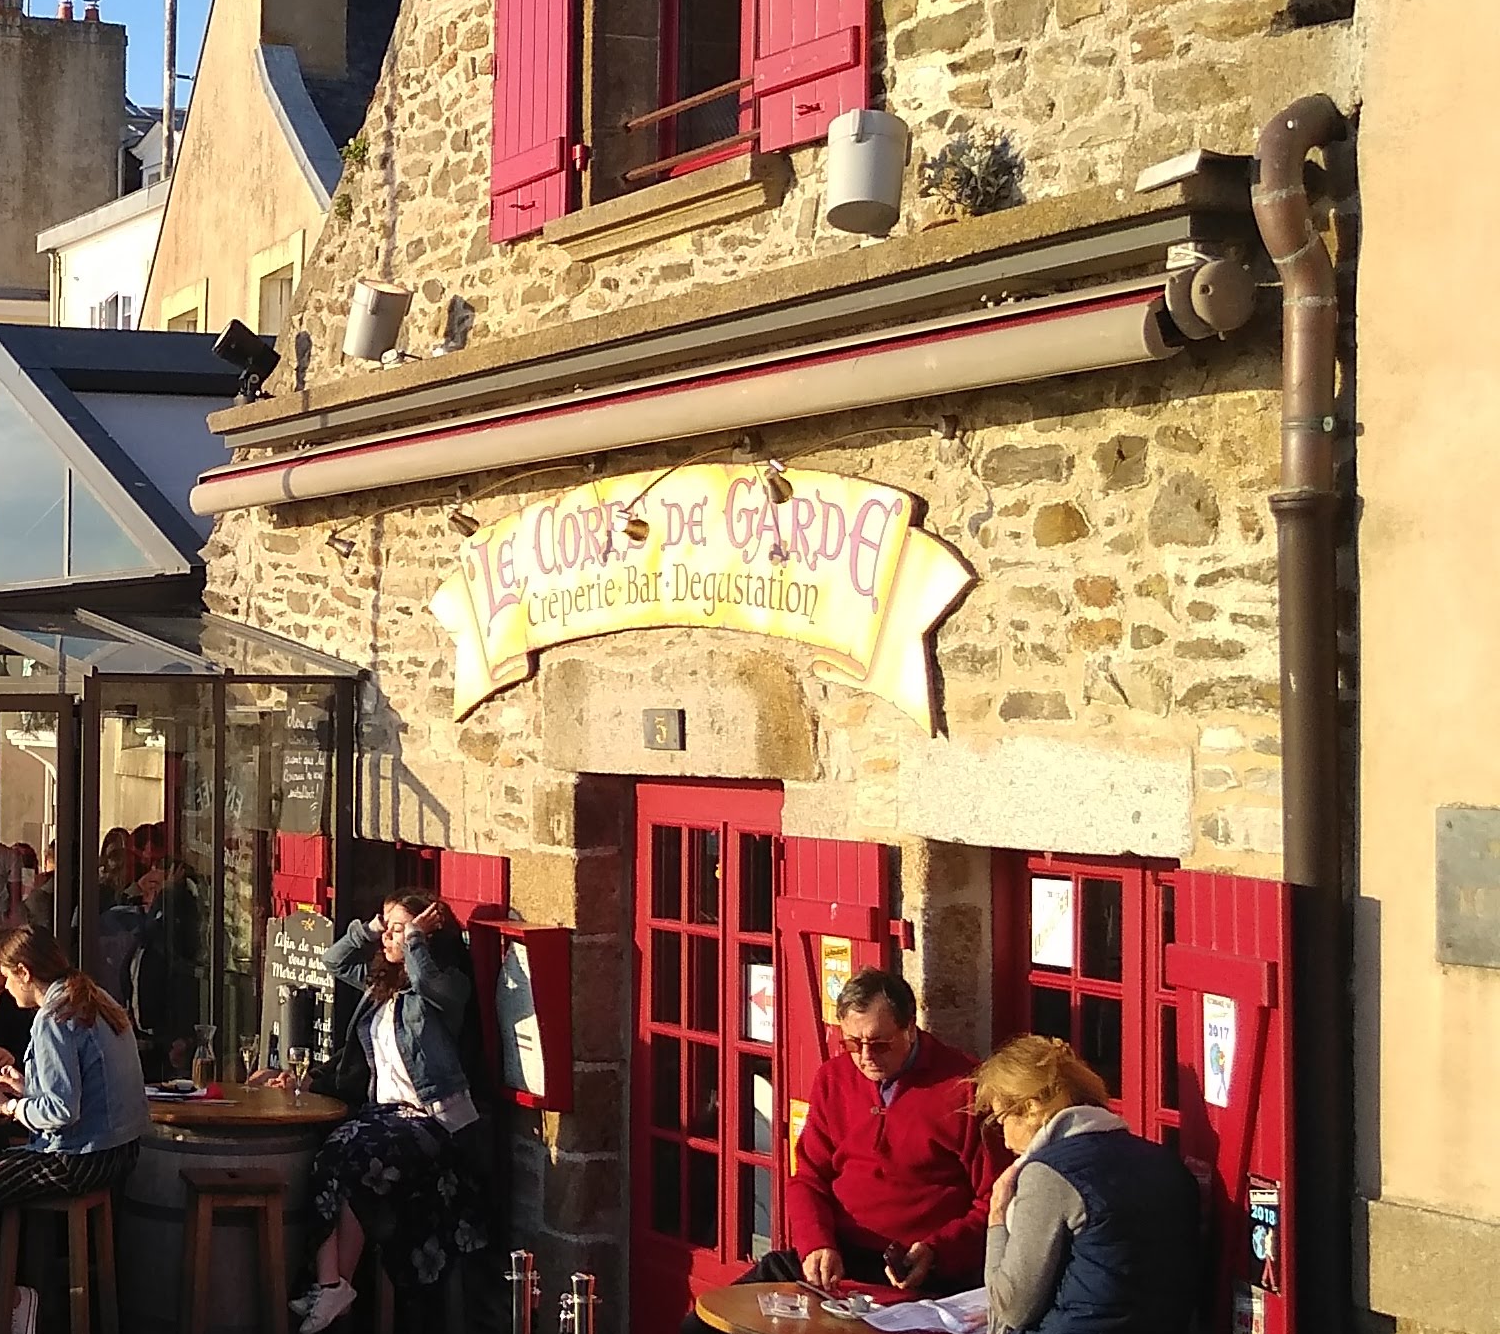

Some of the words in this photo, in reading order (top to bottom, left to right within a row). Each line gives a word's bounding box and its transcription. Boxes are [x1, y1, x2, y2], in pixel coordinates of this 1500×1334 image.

[623, 565, 663, 605] Bar
[273, 931, 296, 955] Afin
[297, 937, 310, 952] de
[1250, 1204, 1277, 1226] 2018
